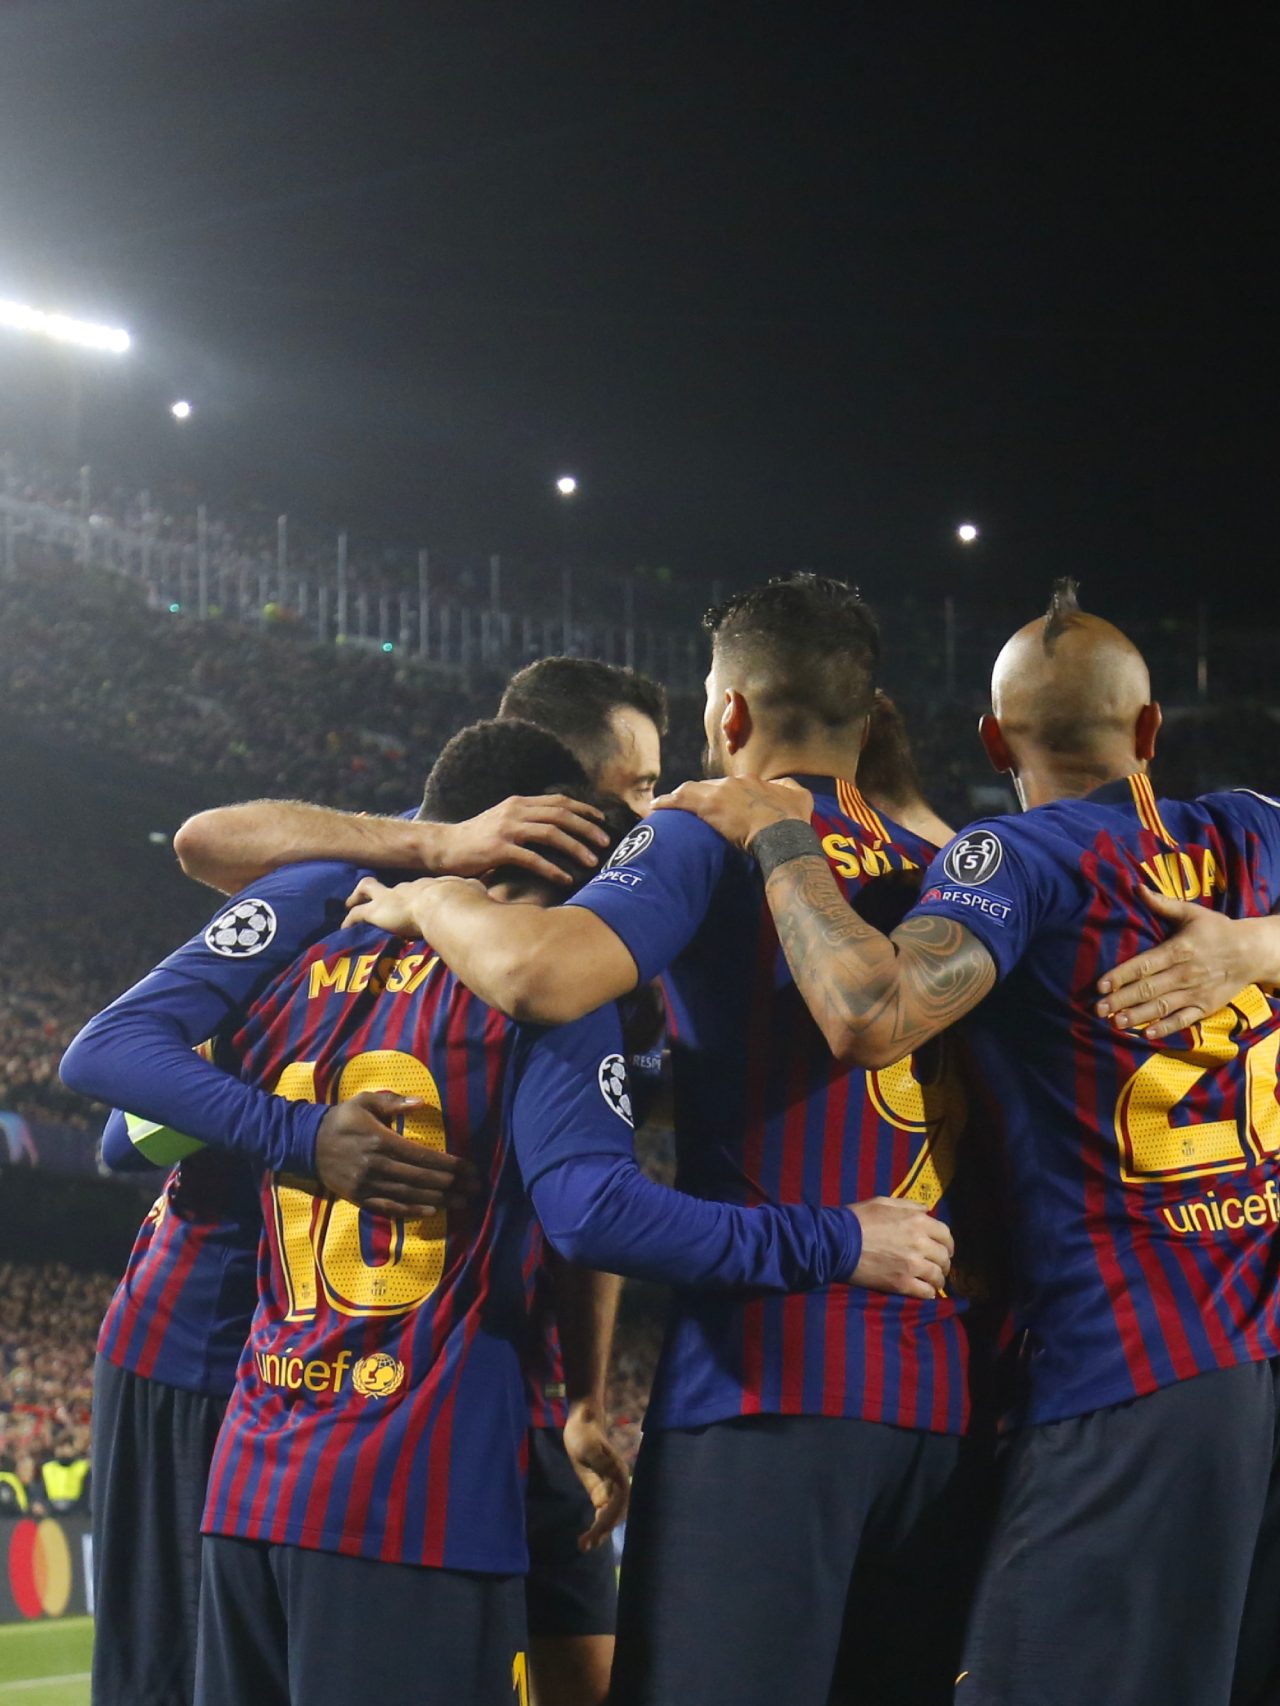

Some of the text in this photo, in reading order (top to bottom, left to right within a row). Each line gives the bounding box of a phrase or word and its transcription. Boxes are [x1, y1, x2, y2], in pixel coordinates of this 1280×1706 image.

[963, 854, 979, 869] 5
[942, 891, 1012, 920] RESPECT
[308, 953, 441, 1000] MESSI
[270, 1049, 448, 1323] 10
[1163, 1179, 1280, 1233] unicef
[254, 1348, 352, 1393] unicef
